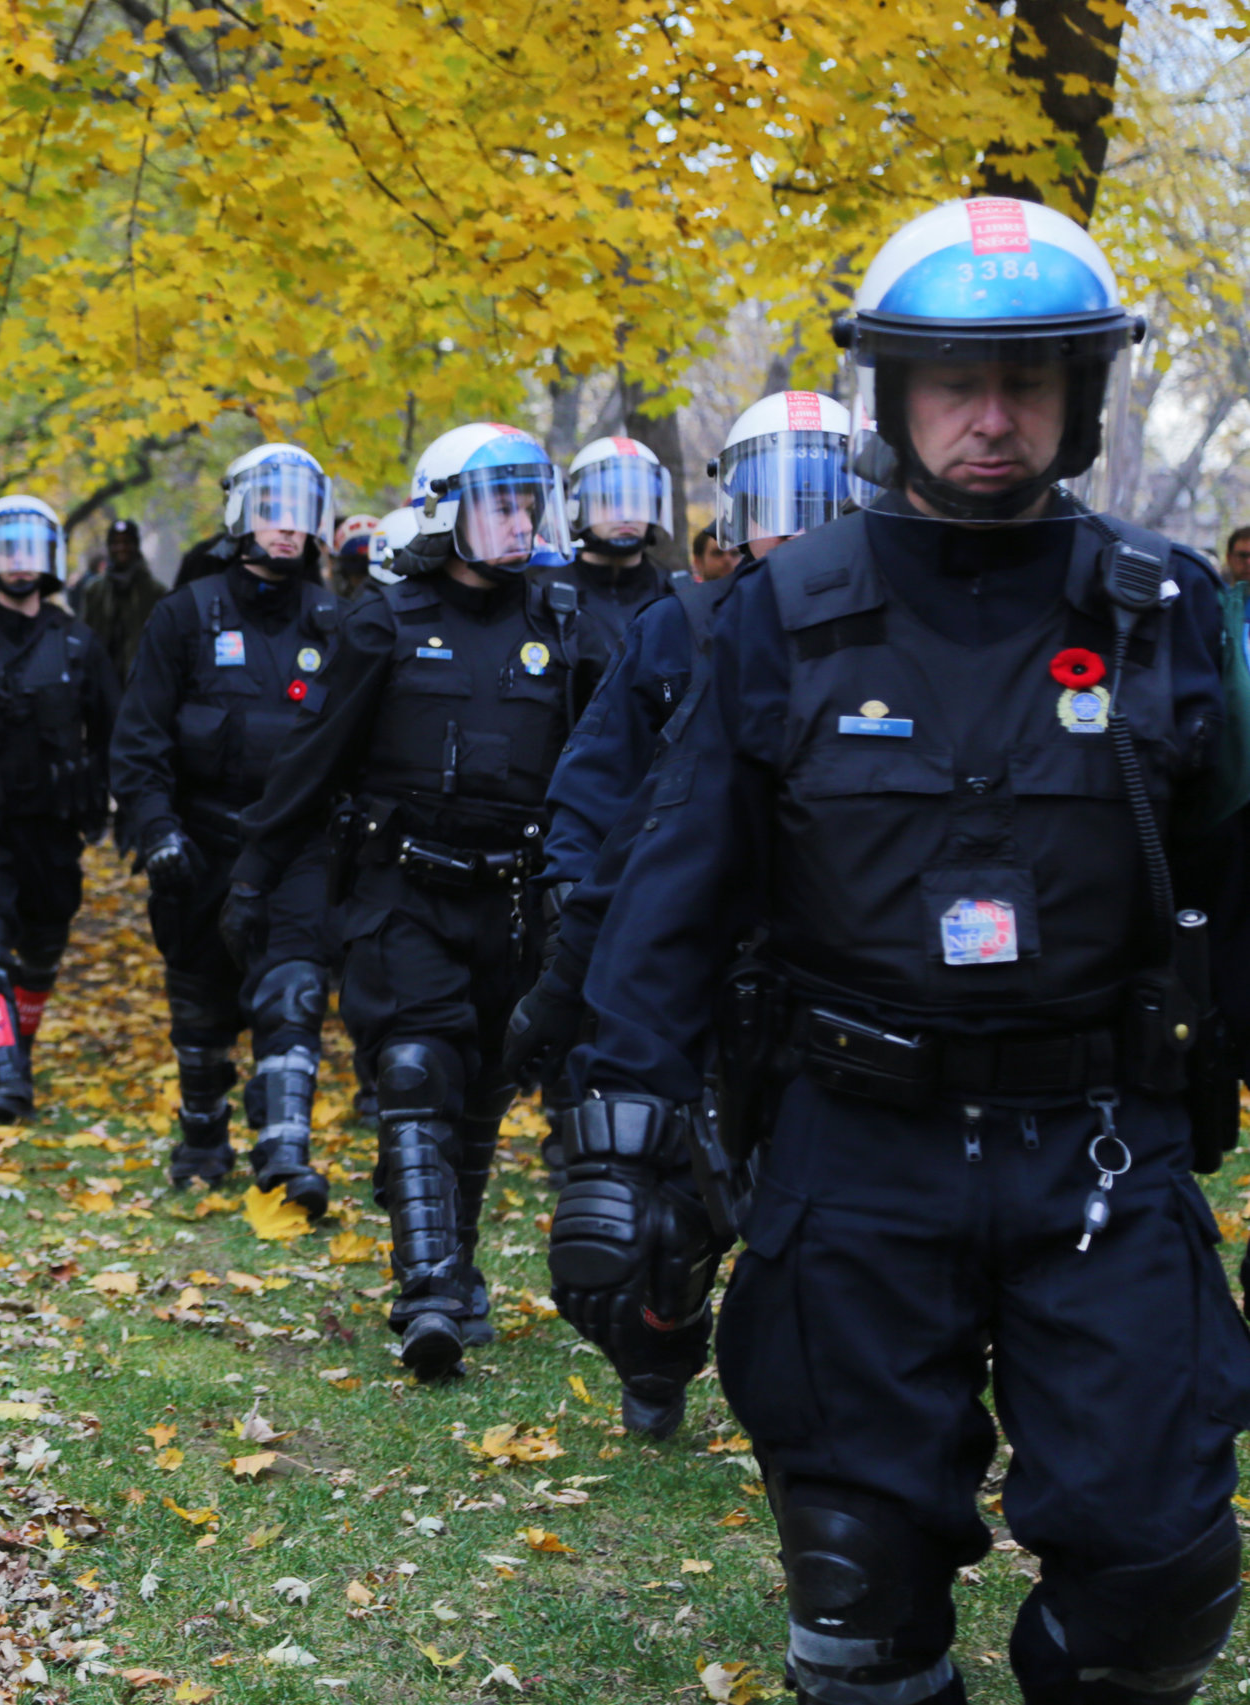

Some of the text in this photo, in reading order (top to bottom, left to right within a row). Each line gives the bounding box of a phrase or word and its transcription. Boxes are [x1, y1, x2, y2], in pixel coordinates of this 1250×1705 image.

[976, 223, 1026, 234] LIBRE
[976, 234, 1029, 249] NÉGO
[958, 260, 1040, 282] 3384
[947, 928, 1010, 951] NÉGO
